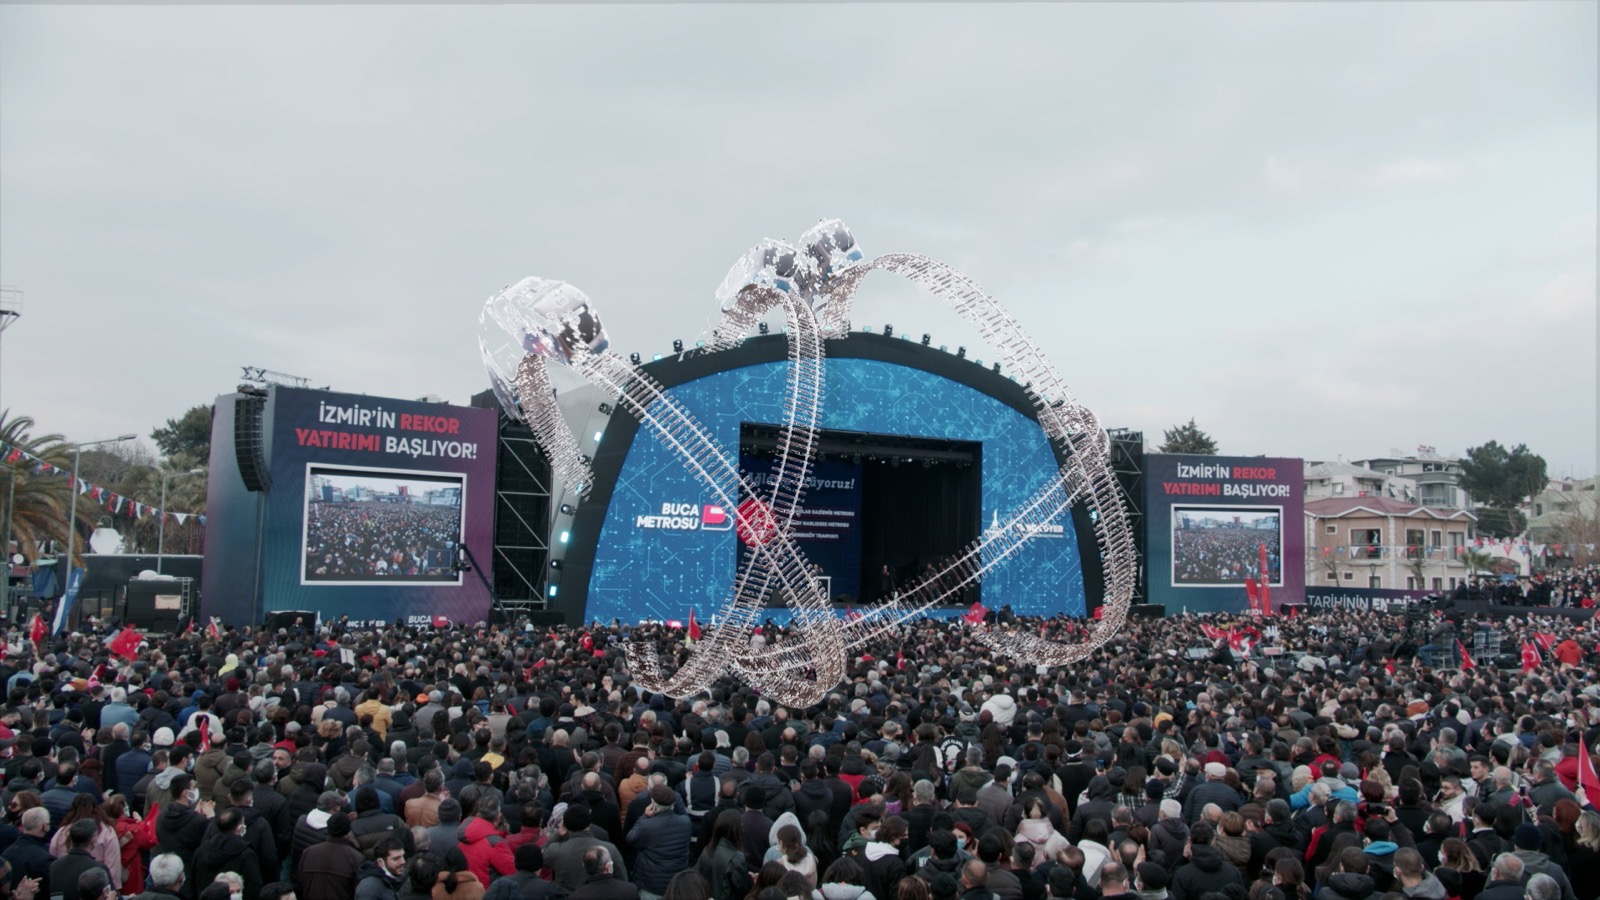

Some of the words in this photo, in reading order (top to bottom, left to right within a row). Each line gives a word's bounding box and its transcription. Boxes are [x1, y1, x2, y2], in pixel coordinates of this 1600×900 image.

[319, 401, 396, 429] İZMİR'İN
[400, 413, 460, 434] REKOR
[295, 428, 381, 452] YATIRIMI
[385, 436, 478, 460] BAŞLIYOR!
[1177, 462, 1230, 479] İZMİR'İN
[1232, 466, 1276, 479] REKOR
[1163, 482, 1221, 496] YATIRIMI
[1223, 483, 1290, 499] BAŞLIYOR!
[661, 502, 700, 516] BUCA
[636, 515, 699, 530] METROSU
[1307, 593, 1369, 610] TARİHİNİN
[408, 615, 432, 624] BUCA
